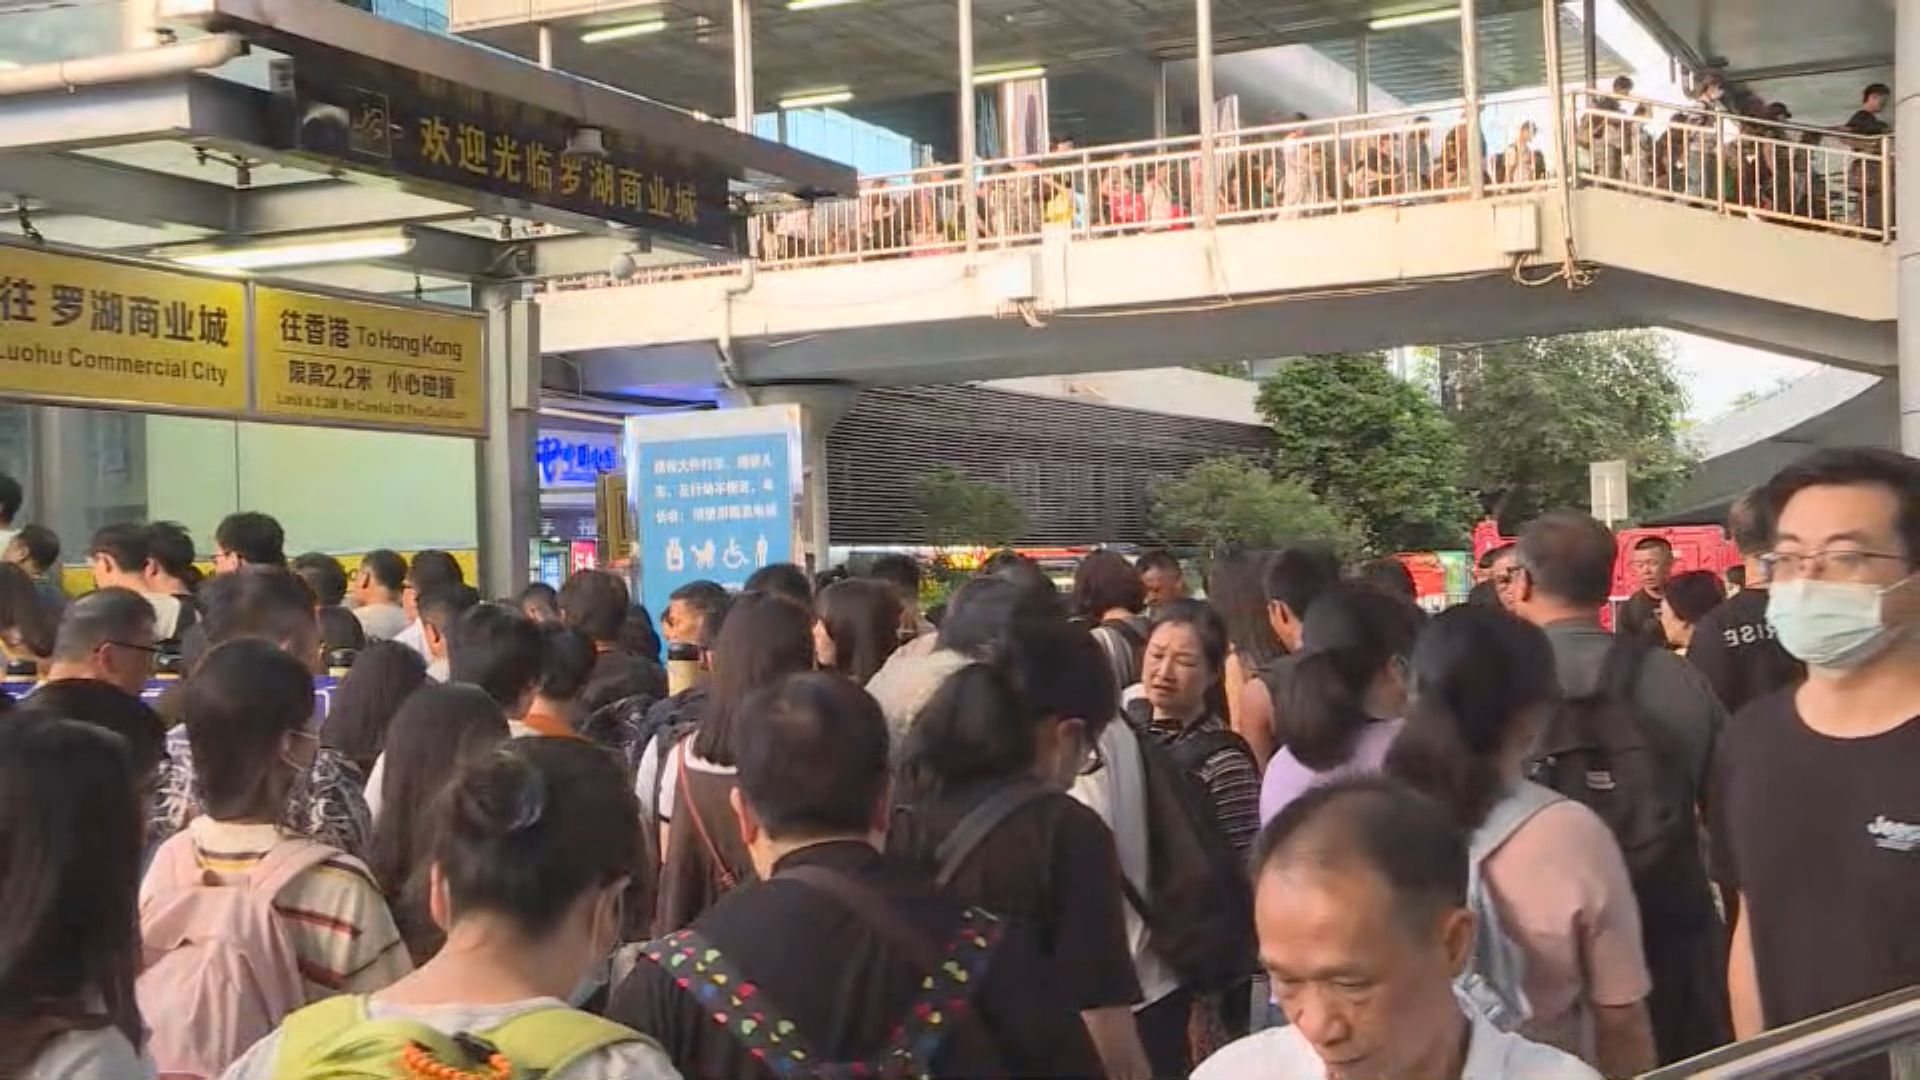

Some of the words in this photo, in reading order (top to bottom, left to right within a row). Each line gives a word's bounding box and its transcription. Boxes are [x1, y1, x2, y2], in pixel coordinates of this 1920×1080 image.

[420, 116, 698, 225] 欢迎光临罗湖商业城
[0, 276, 37, 322] 往
[51, 283, 230, 347] 罗湖商业城
[280, 308, 349, 349] 往香港
[355, 326, 376, 348] To
[379, 329, 420, 357] Hong
[422, 333, 463, 362] Kong
[68, 346, 187, 379] Commercial
[191, 361, 228, 387] City
[288, 359, 373, 392] 限高2.2米
